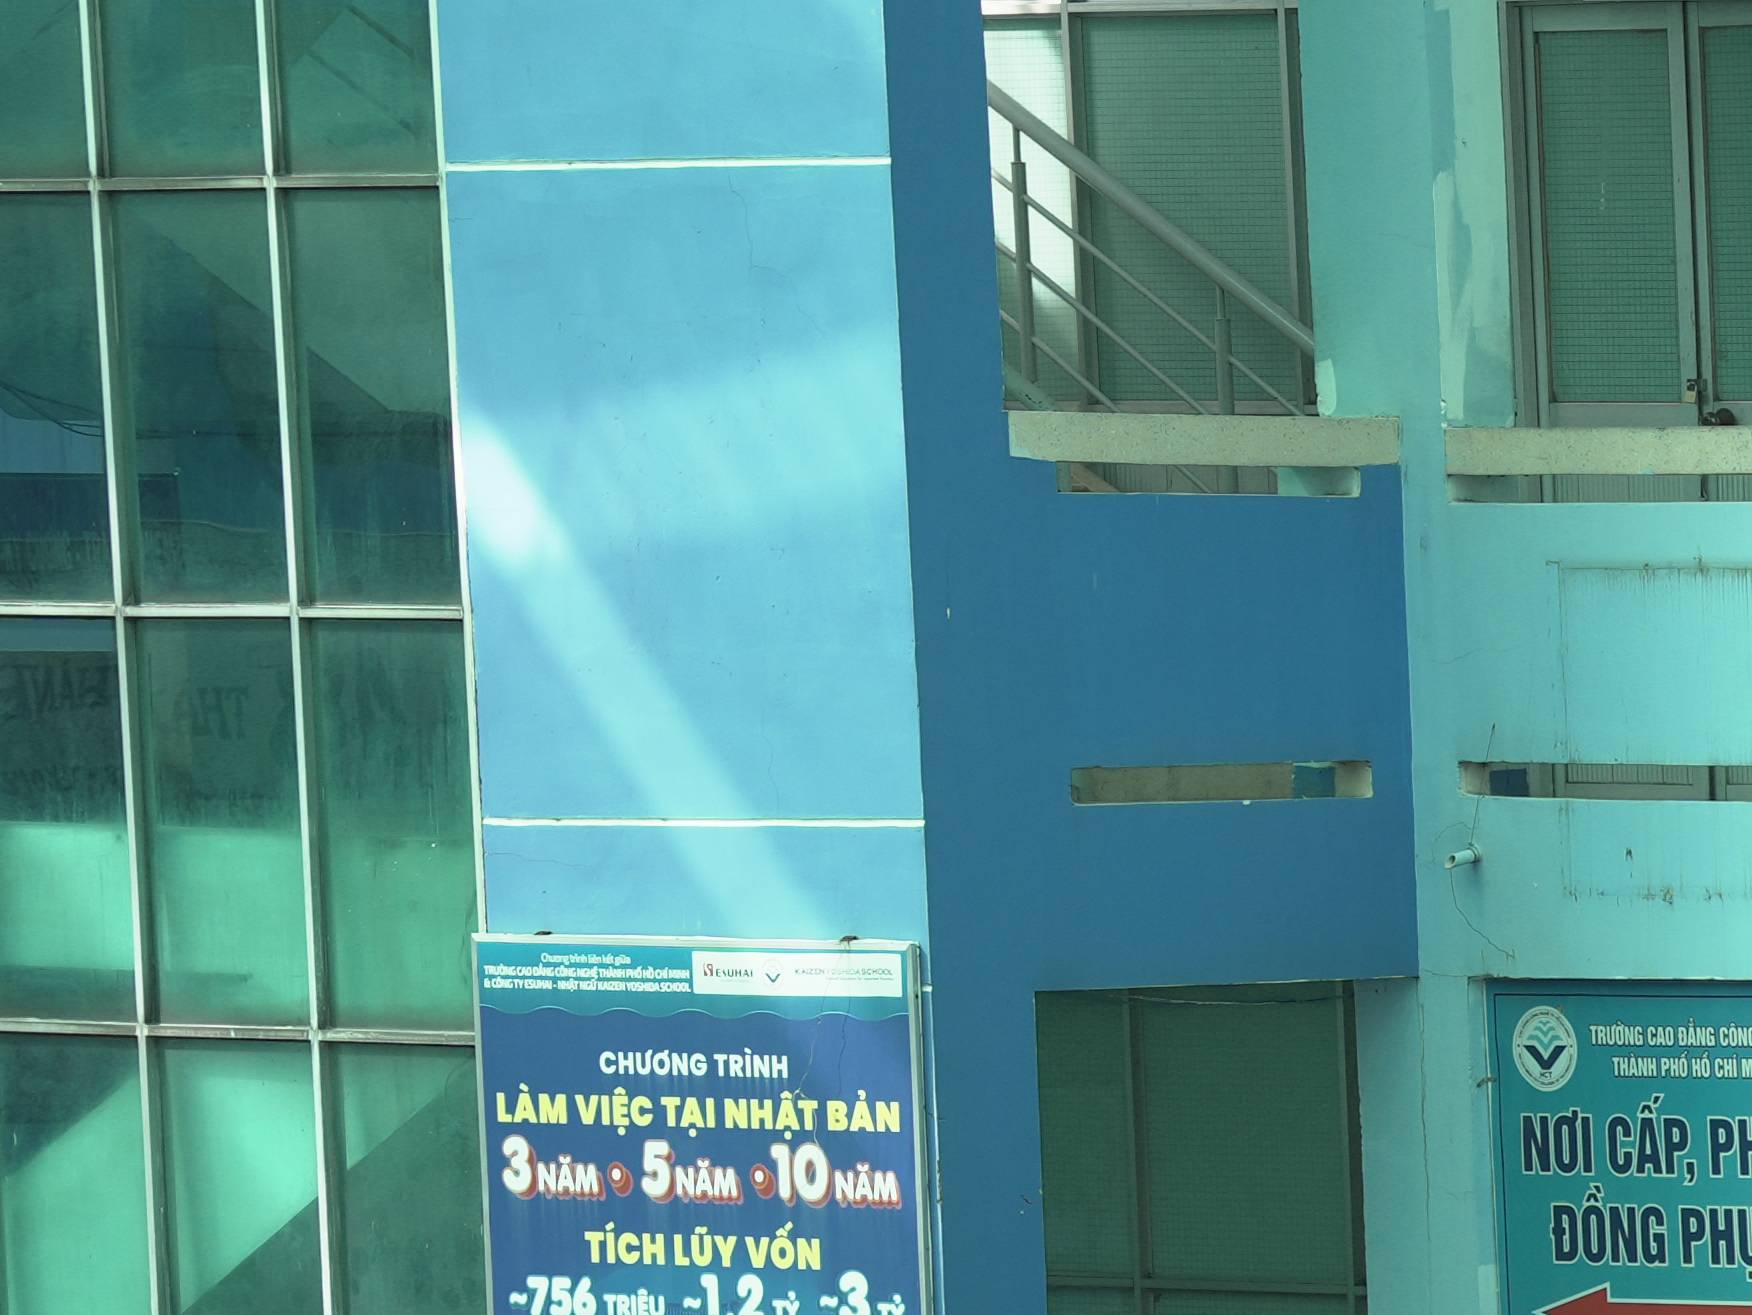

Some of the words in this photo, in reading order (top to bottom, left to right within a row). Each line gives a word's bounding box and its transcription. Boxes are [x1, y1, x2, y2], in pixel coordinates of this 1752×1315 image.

[1590, 1022, 1643, 1046] TRƯỜNG
[1648, 1027, 1674, 1046] CAO
[1679, 1018, 1715, 1048] ĐẲNG
[599, 1050, 708, 1076] CHƯƠNG
[713, 1048, 788, 1078] TRÌNH
[1612, 1052, 1657, 1078] THÀNH
[1661, 1052, 1688, 1079] PHỐ
[1693, 1053, 1711, 1079] HỒ
[1715, 1053, 1738, 1079] CHÍ
[496, 1082, 568, 1124] LÀM
[575, 1087, 654, 1136] VIỆC
[661, 1097, 716, 1137] TẠI
[724, 1091, 818, 1140] NHẬT
[827, 1089, 901, 1132] BẢN
[1520, 1108, 1595, 1176] NƠI
[1606, 1094, 1697, 1186] CẤP,
[503, 1135, 532, 1194] 3
[538, 1154, 599, 1193] NĂM
[642, 1139, 670, 1195] 5
[676, 1159, 737, 1197] NĂM
[770, 1142, 828, 1201] 10
[835, 1163, 898, 1202] NĂM
[584, 1222, 665, 1265] TÍCH
[674, 1226, 737, 1267] LŨY
[745, 1221, 821, 1271] VỐN
[1550, 1183, 1669, 1267] ĐỒNG
